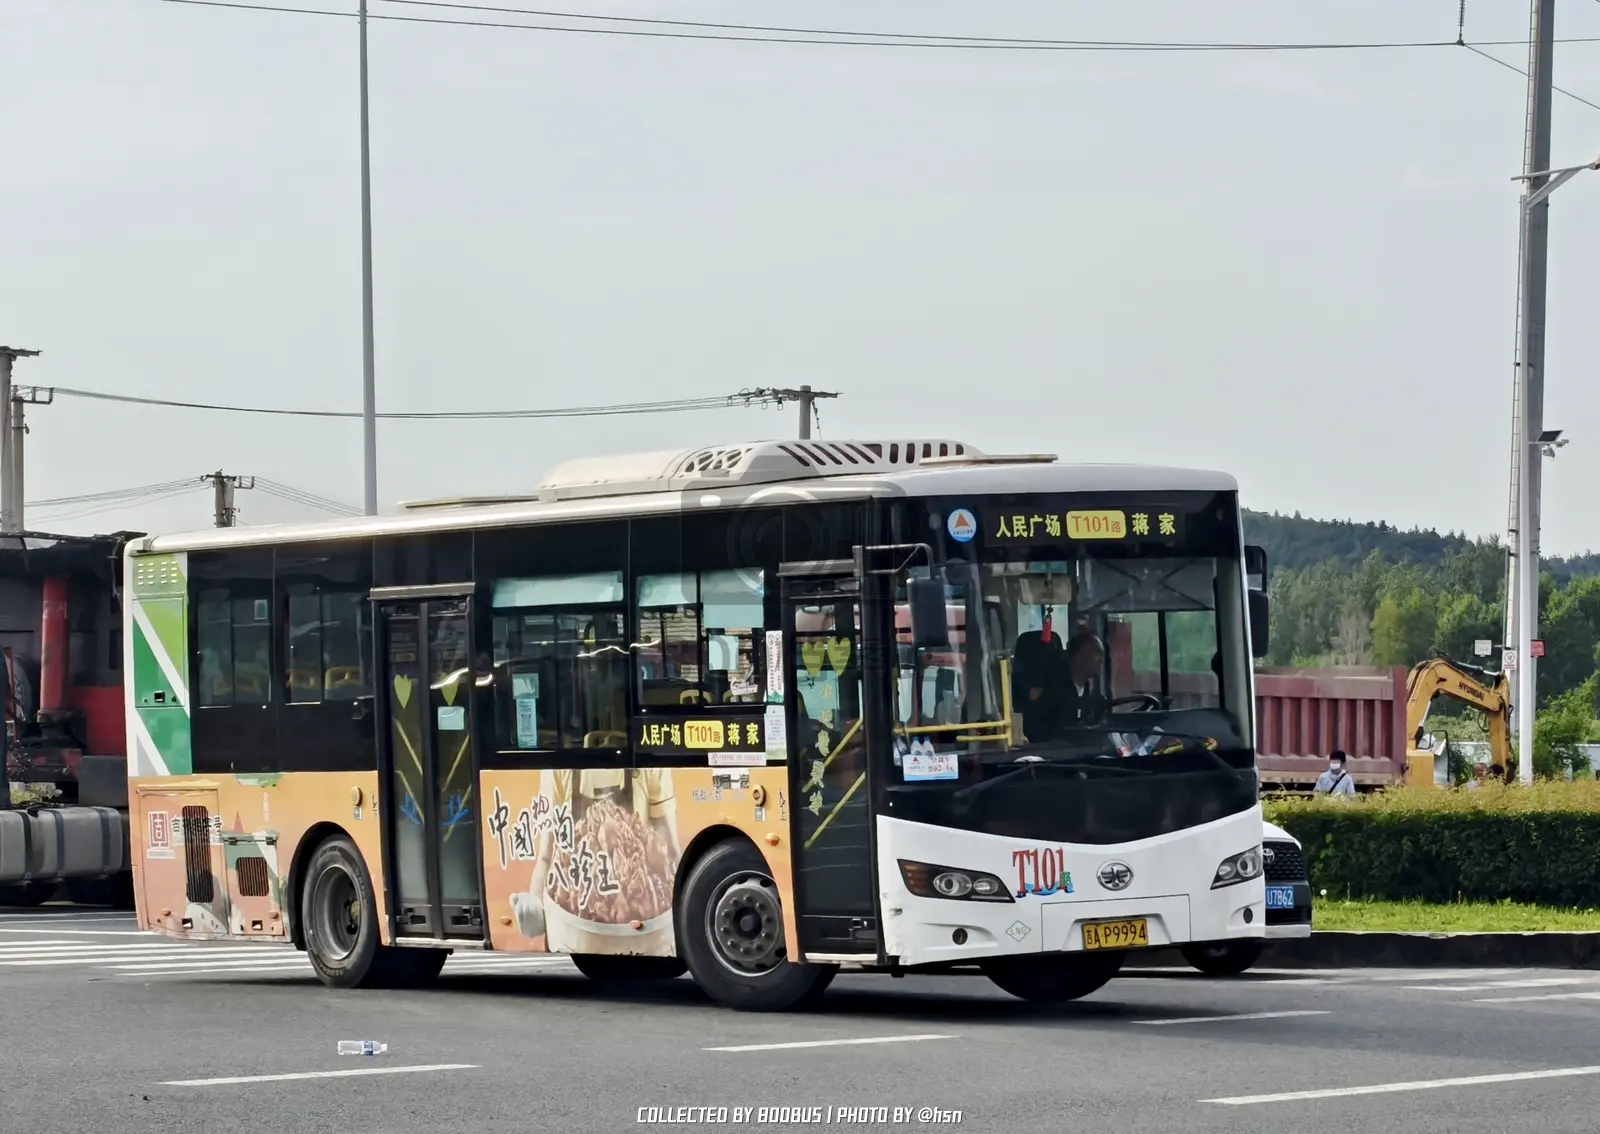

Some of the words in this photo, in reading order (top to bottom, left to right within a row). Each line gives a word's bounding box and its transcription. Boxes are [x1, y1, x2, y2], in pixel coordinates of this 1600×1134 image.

[995, 515, 1061, 538] 人民广场
[1070, 514, 1121, 534] T101路
[1458, 681, 1485, 701] HYUNDAI
[639, 724, 682, 746] 人民广场
[687, 726, 721, 744] T101路
[547, 840, 620, 907] 八珍王
